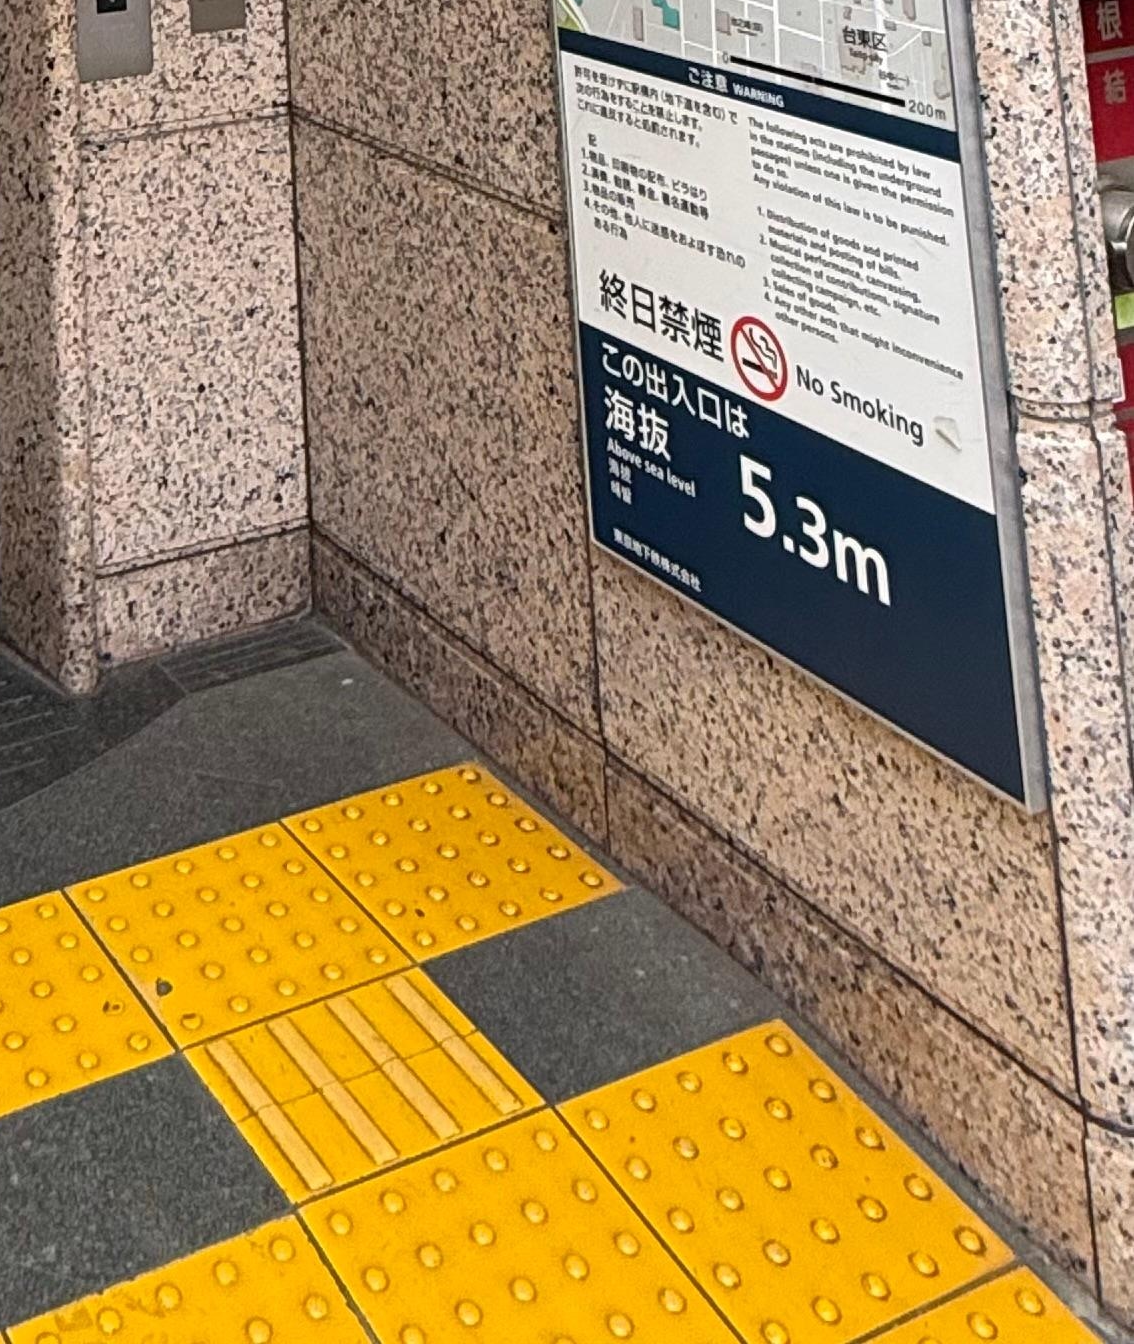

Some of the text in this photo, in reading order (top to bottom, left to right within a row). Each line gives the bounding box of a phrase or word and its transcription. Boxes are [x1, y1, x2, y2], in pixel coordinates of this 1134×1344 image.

[1096, 0, 1123, 41] 根
[732, 82, 785, 108] WARNING
[907, 98, 947, 122] 200m
[598, 268, 724, 362] 終日禁煙
[601, 341, 749, 438] この出入口は
[603, 385, 670, 461] 海抜
[796, 364, 923, 447] No Smoking
[606, 436, 695, 497] Above sea level
[739, 454, 890, 605] 5.3m
